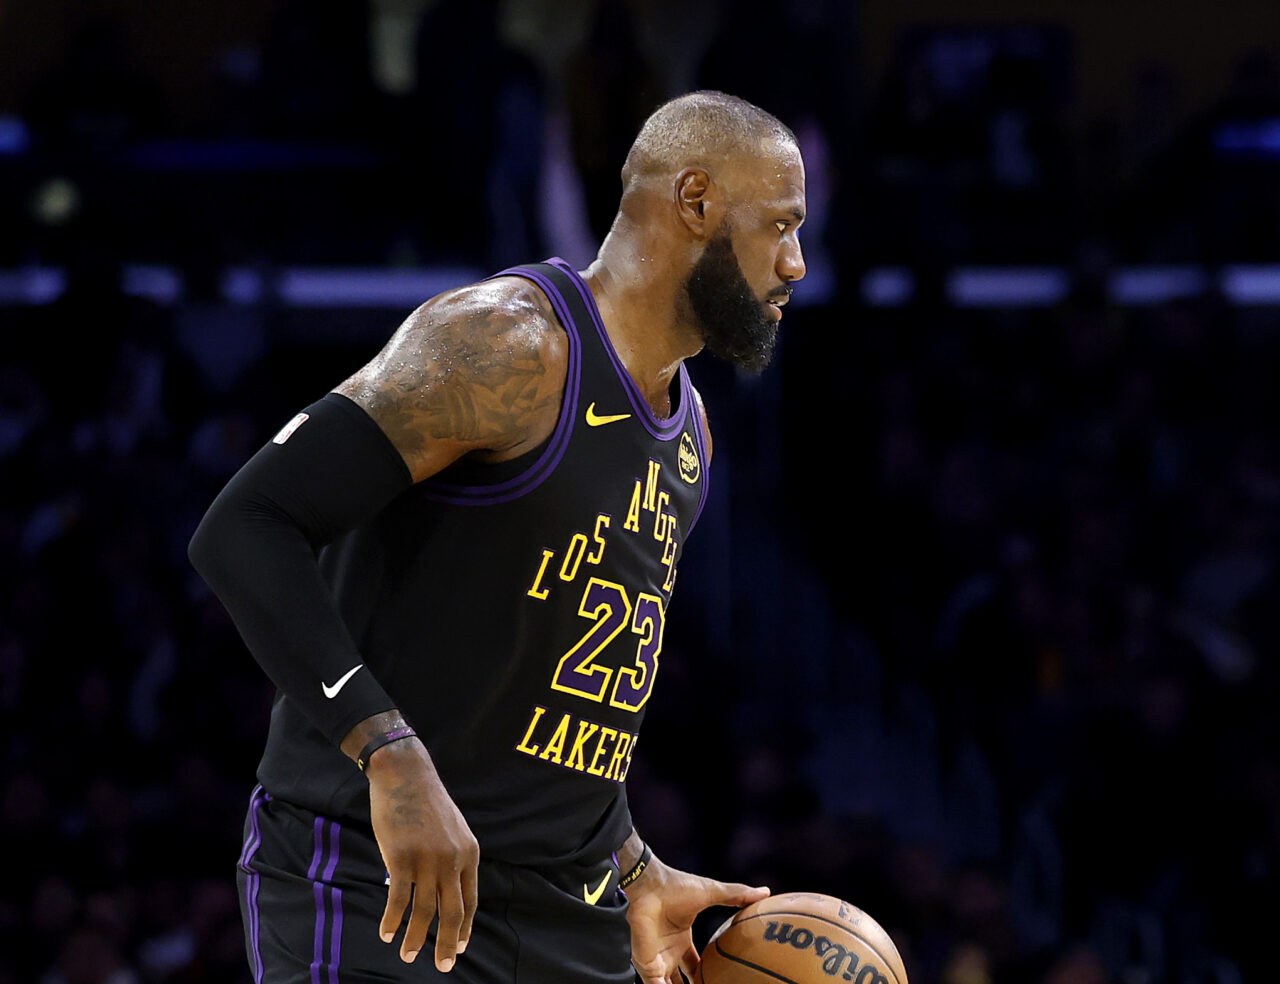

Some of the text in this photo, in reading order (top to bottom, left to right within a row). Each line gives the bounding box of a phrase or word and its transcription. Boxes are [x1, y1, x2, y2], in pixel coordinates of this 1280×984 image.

[527, 459, 677, 600] LOS ANGEL
[550, 576, 666, 713] 23
[515, 706, 639, 783] LAKERS
